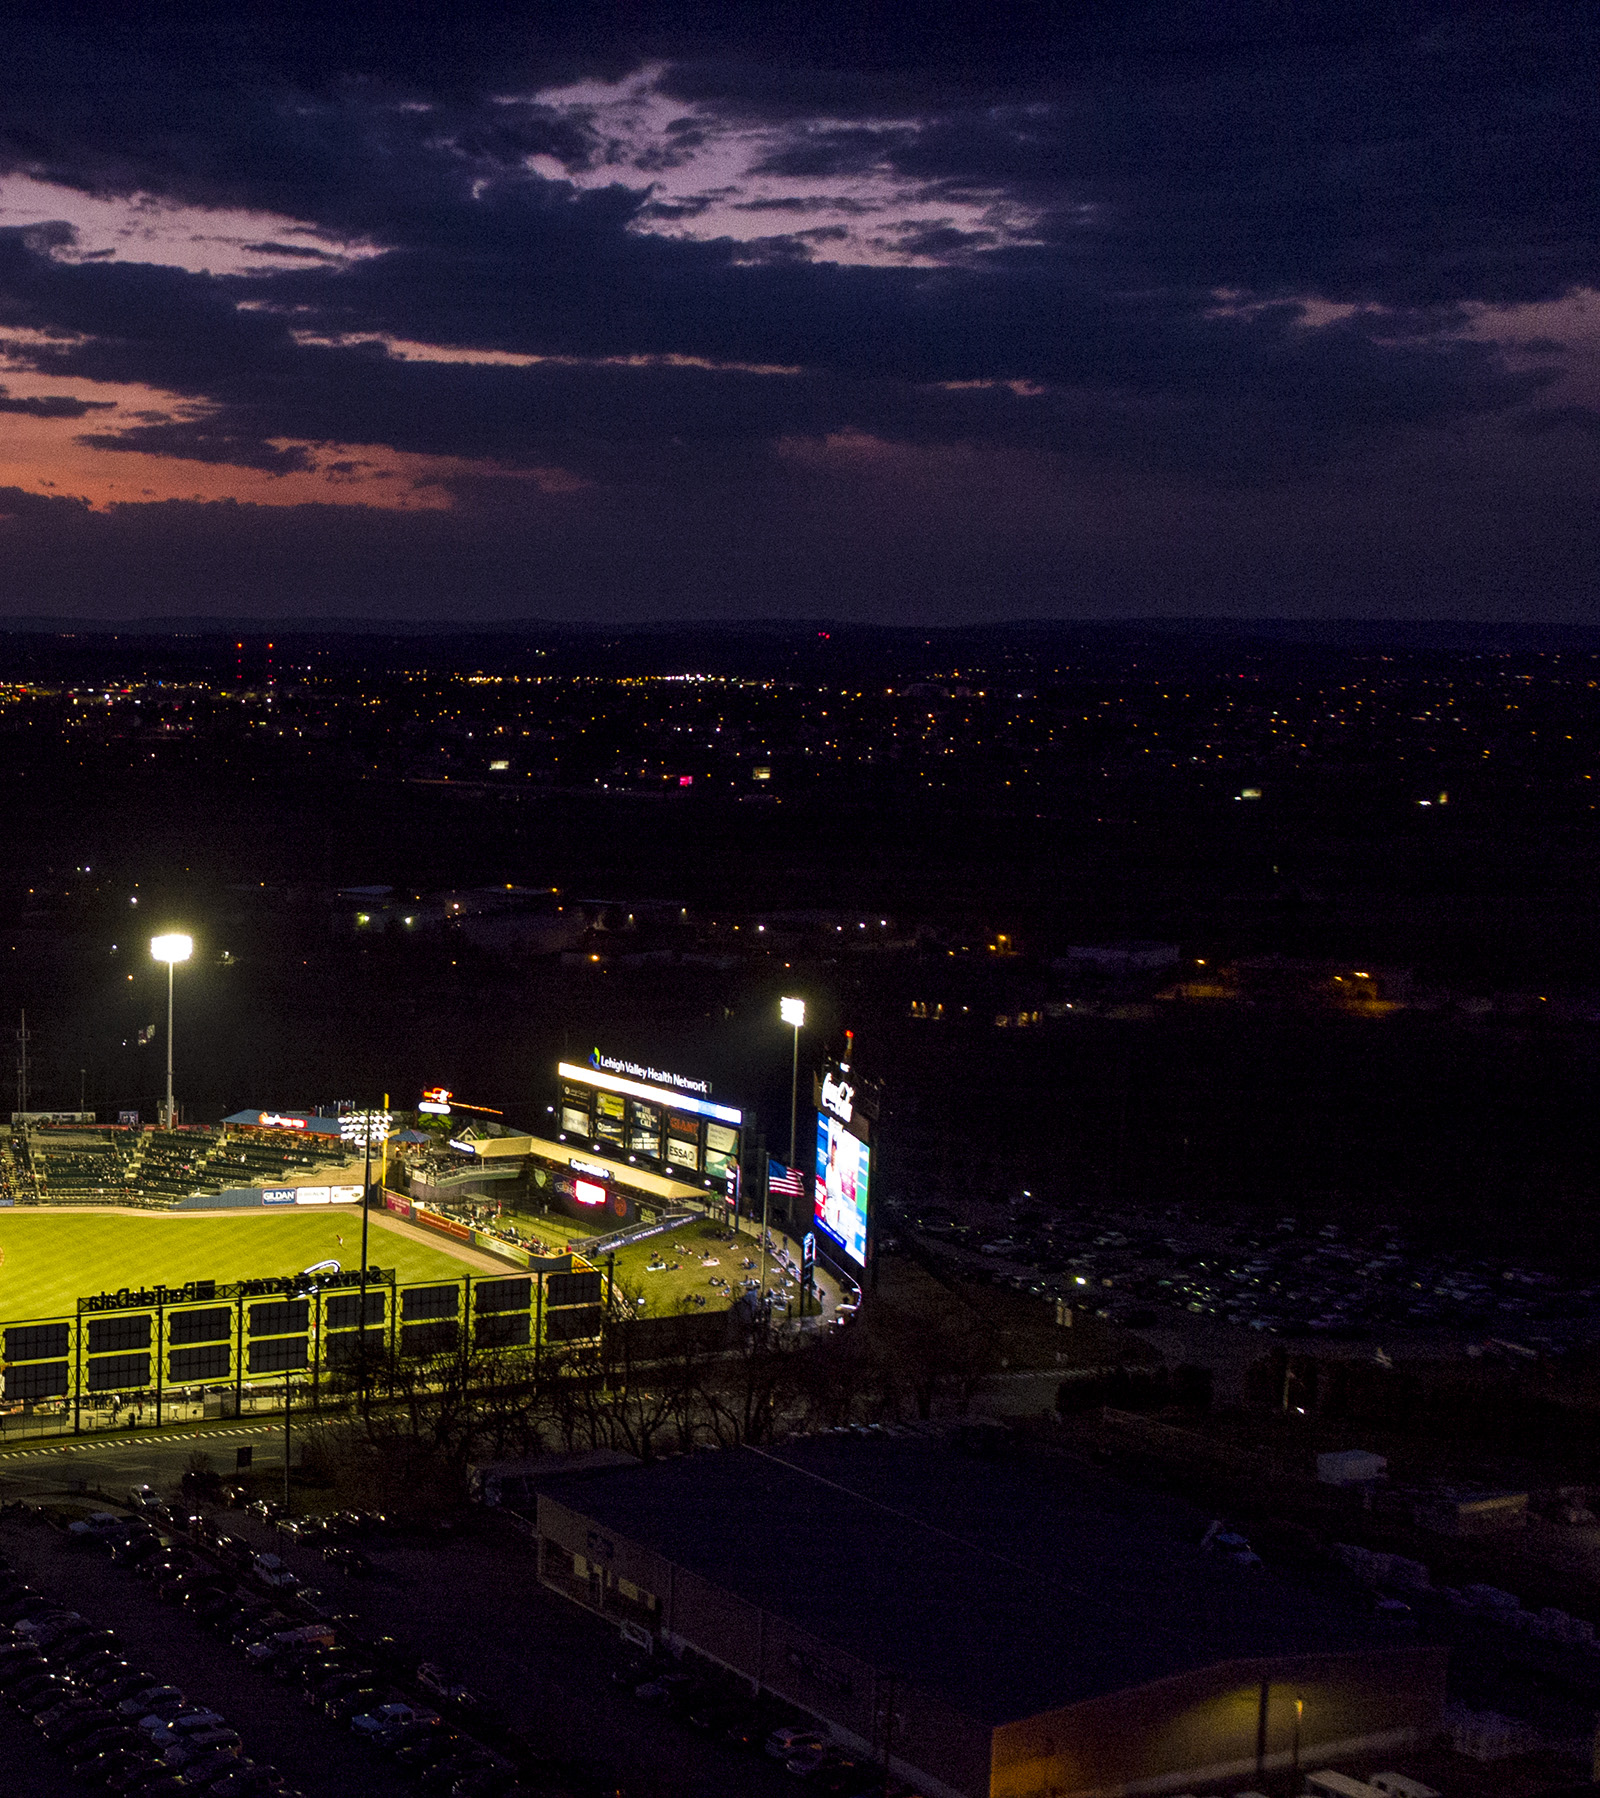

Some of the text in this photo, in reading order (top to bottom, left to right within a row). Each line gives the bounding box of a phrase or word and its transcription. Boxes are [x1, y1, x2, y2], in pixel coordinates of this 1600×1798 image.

[600, 1055, 707, 1093] Lehigh Valley Health Network
[670, 1117, 699, 1134] GIANT
[669, 1145, 688, 1160] ESSA
[263, 1191, 295, 1201] GILDAN
